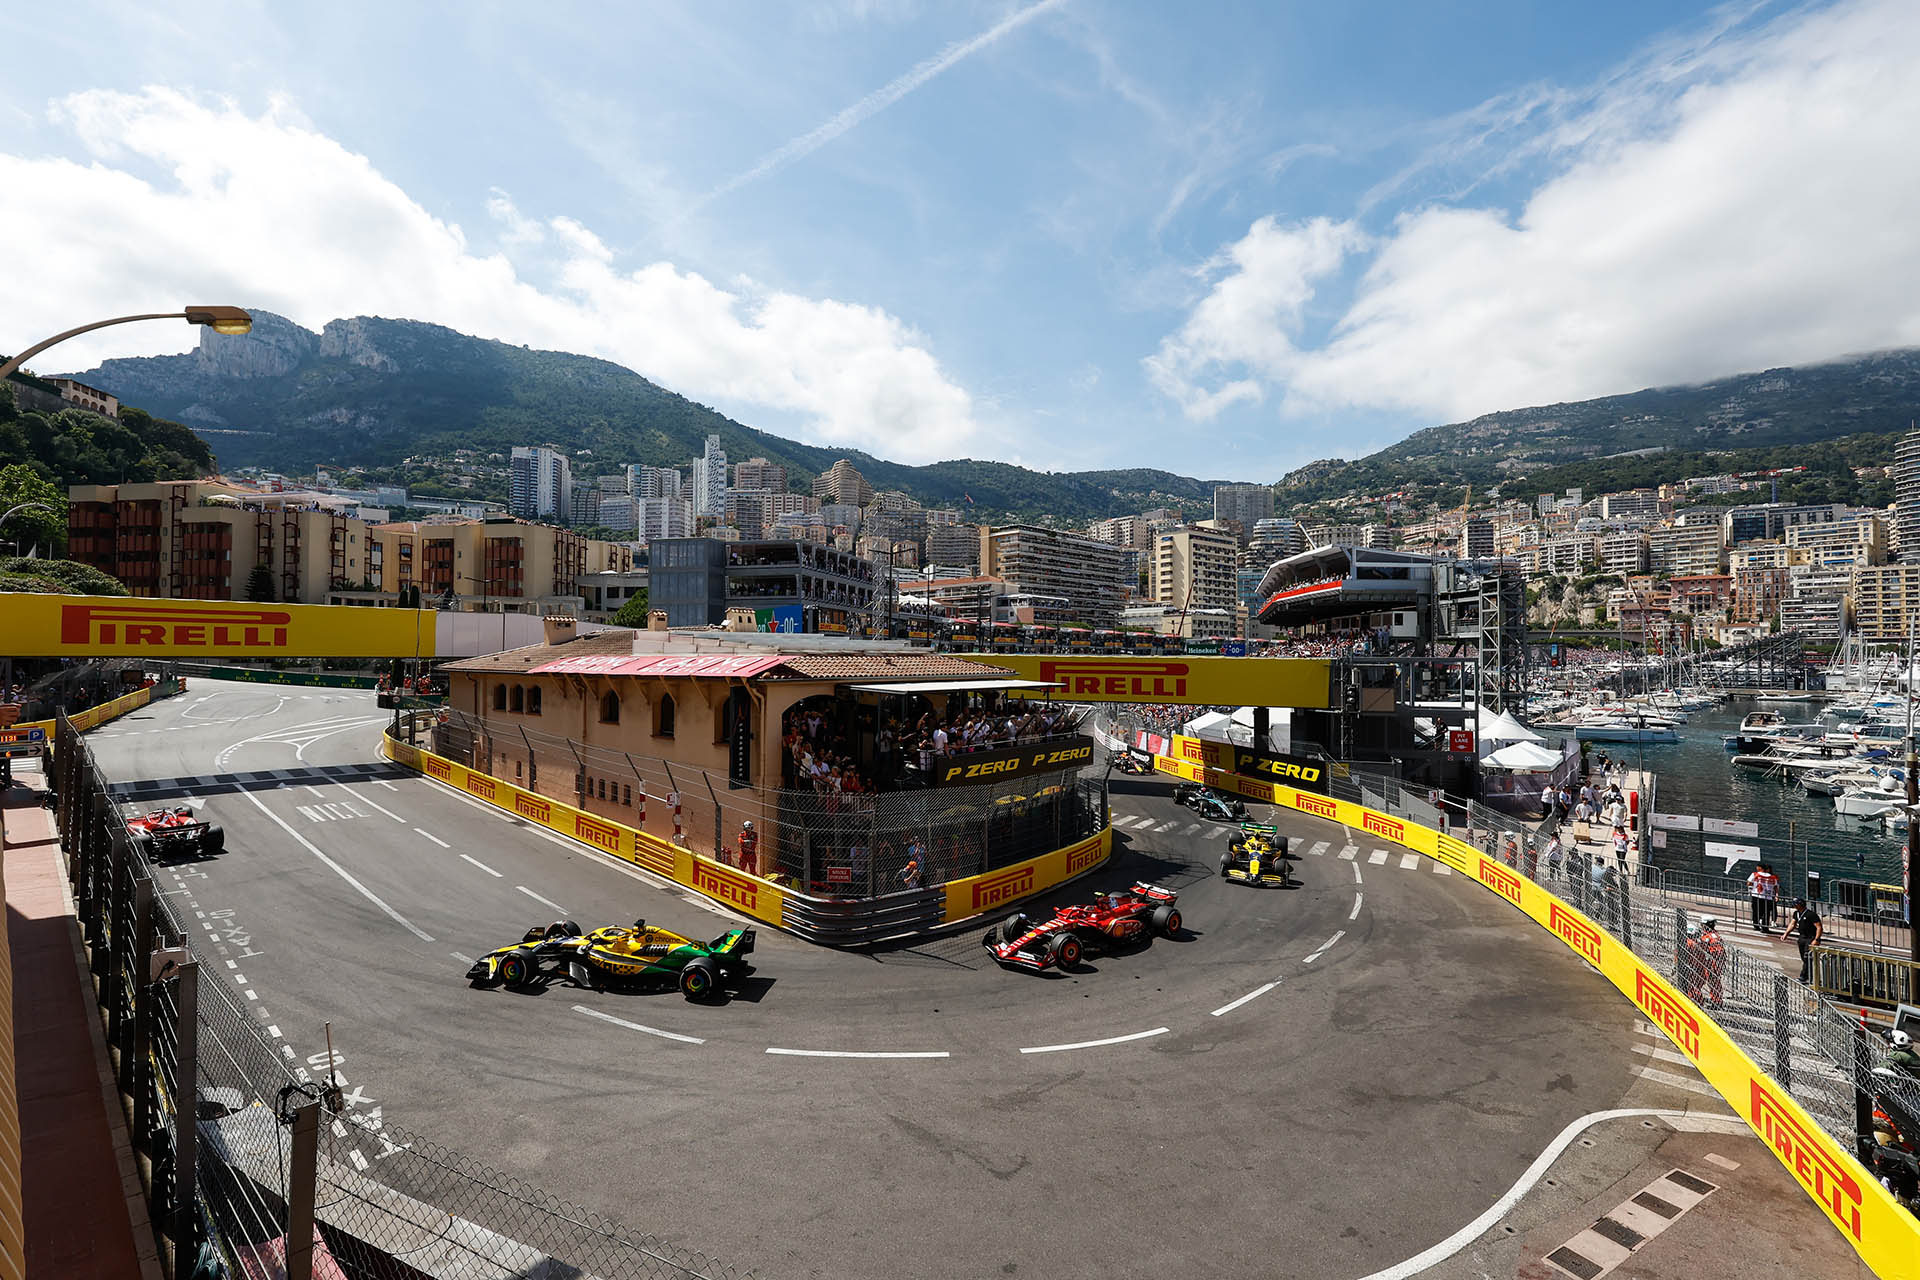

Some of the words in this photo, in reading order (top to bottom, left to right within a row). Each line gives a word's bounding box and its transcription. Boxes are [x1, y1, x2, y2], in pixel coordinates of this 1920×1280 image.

[61, 605, 291, 646] PIRELLI
[559, 656, 640, 667] CASINO
[656, 656, 764, 667] CASINO
[1040, 662, 1190, 697] PIRELLI
[1032, 754, 1046, 766] P
[1048, 747, 1091, 763] ZERO
[1160, 758, 1178, 774] PIRELLI
[1183, 740, 1219, 764] PIRELLI
[427, 757, 450, 780] PIRELLI
[946, 767, 962, 781] P
[965, 758, 1020, 778] ZERO
[1193, 768, 1218, 786] PIRELLI
[1240, 754, 1253, 766] P
[1257, 758, 1320, 782] ZERO
[467, 773, 495, 800] PIRELLI
[1238, 780, 1273, 800] PIRELLI
[296, 802, 371, 822] NICE
[516, 792, 550, 823] PIRELLI
[1296, 793, 1337, 818] PIRELLI
[576, 815, 620, 850] PIRELLI
[1363, 812, 1404, 841] PIRELLI
[1066, 838, 1102, 874] PIRELLI
[692, 860, 757, 910] PIRELLI
[973, 866, 1034, 909] PIRELLI
[1480, 858, 1521, 904] PIRELLI
[1550, 902, 1602, 965] PIRELLI
[1636, 968, 1700, 1061] PIRELLI
[1751, 1078, 1863, 1242] PIRELLI
